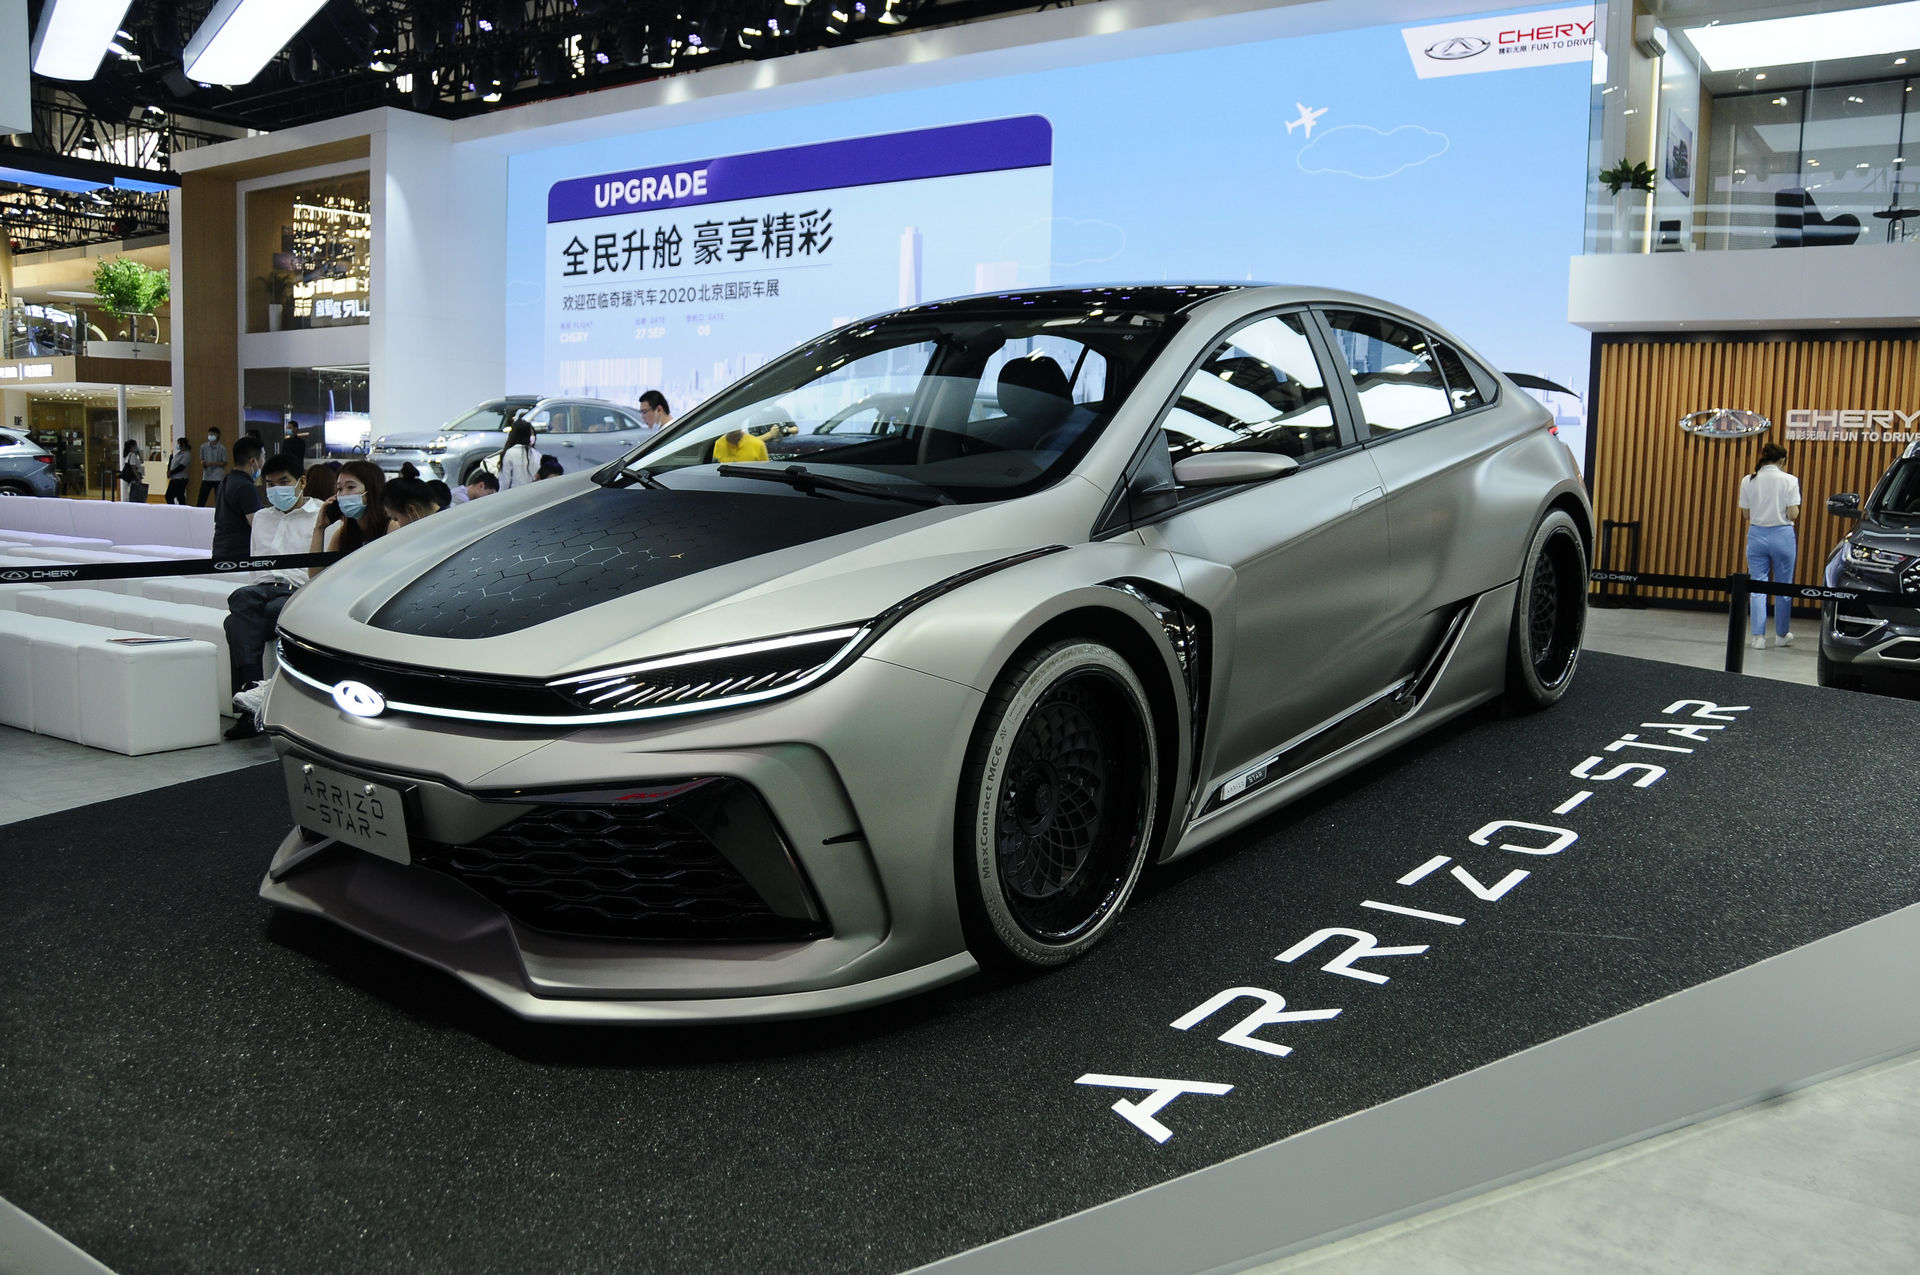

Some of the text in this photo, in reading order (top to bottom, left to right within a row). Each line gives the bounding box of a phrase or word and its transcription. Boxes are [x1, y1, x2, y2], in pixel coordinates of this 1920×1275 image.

[1498, 20, 1594, 44] CHERY
[1531, 37, 1594, 51] FUN TO DRIVE
[594, 170, 708, 208] UPGRADE
[562, 208, 833, 277] 全民升舱 豪享精彩
[1786, 409, 1920, 429] CHERY
[1832, 431, 1858, 442] FUN
[1861, 432, 1880, 442] TO
[239, 559, 277, 569] CHERY
[32, 569, 79, 578] CHERY
[1608, 573, 1638, 582] CHERY
[1822, 590, 1858, 600] CHERY
[1247, 771, 1264, 783] STAR
[304, 776, 384, 820] ARRIZO
[980, 745, 1003, 880] MaxContact MC6
